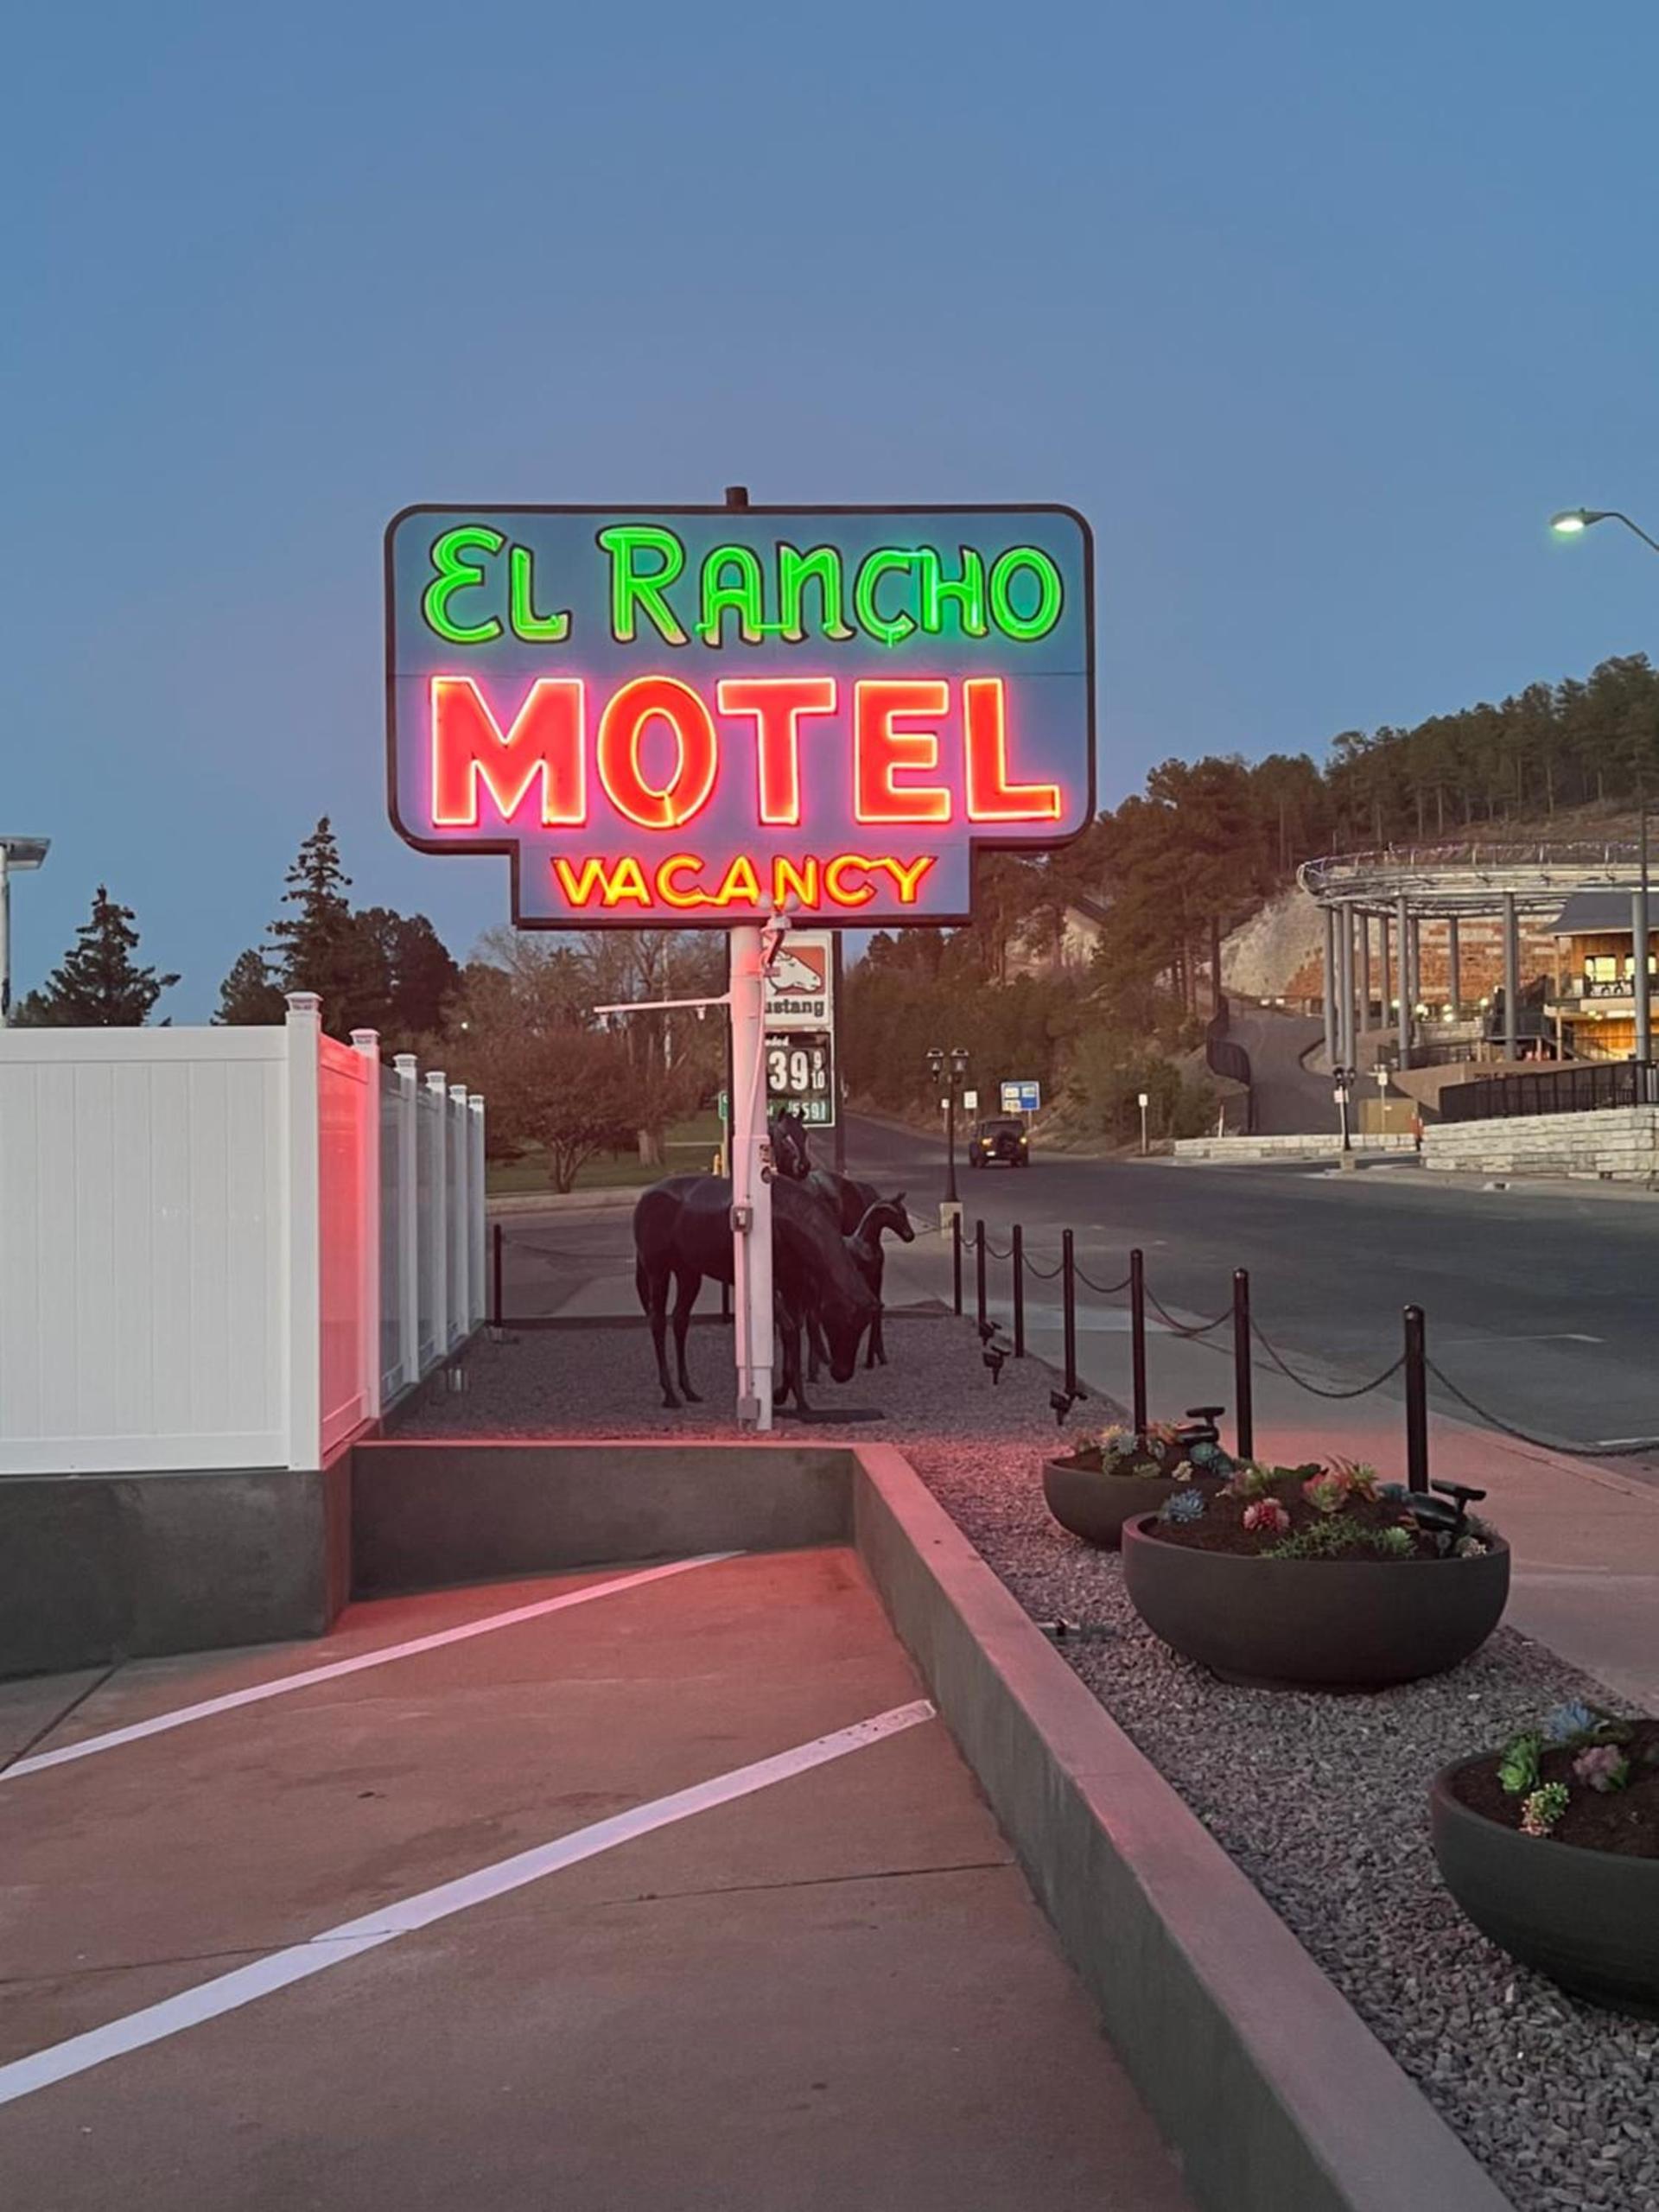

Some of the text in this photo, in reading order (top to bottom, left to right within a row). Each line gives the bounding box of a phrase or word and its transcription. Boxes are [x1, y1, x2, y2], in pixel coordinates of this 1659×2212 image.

[430, 676, 1061, 827] MOTEL
[552, 855, 936, 908] VACANCY
[764, 998, 824, 1017] ustang
